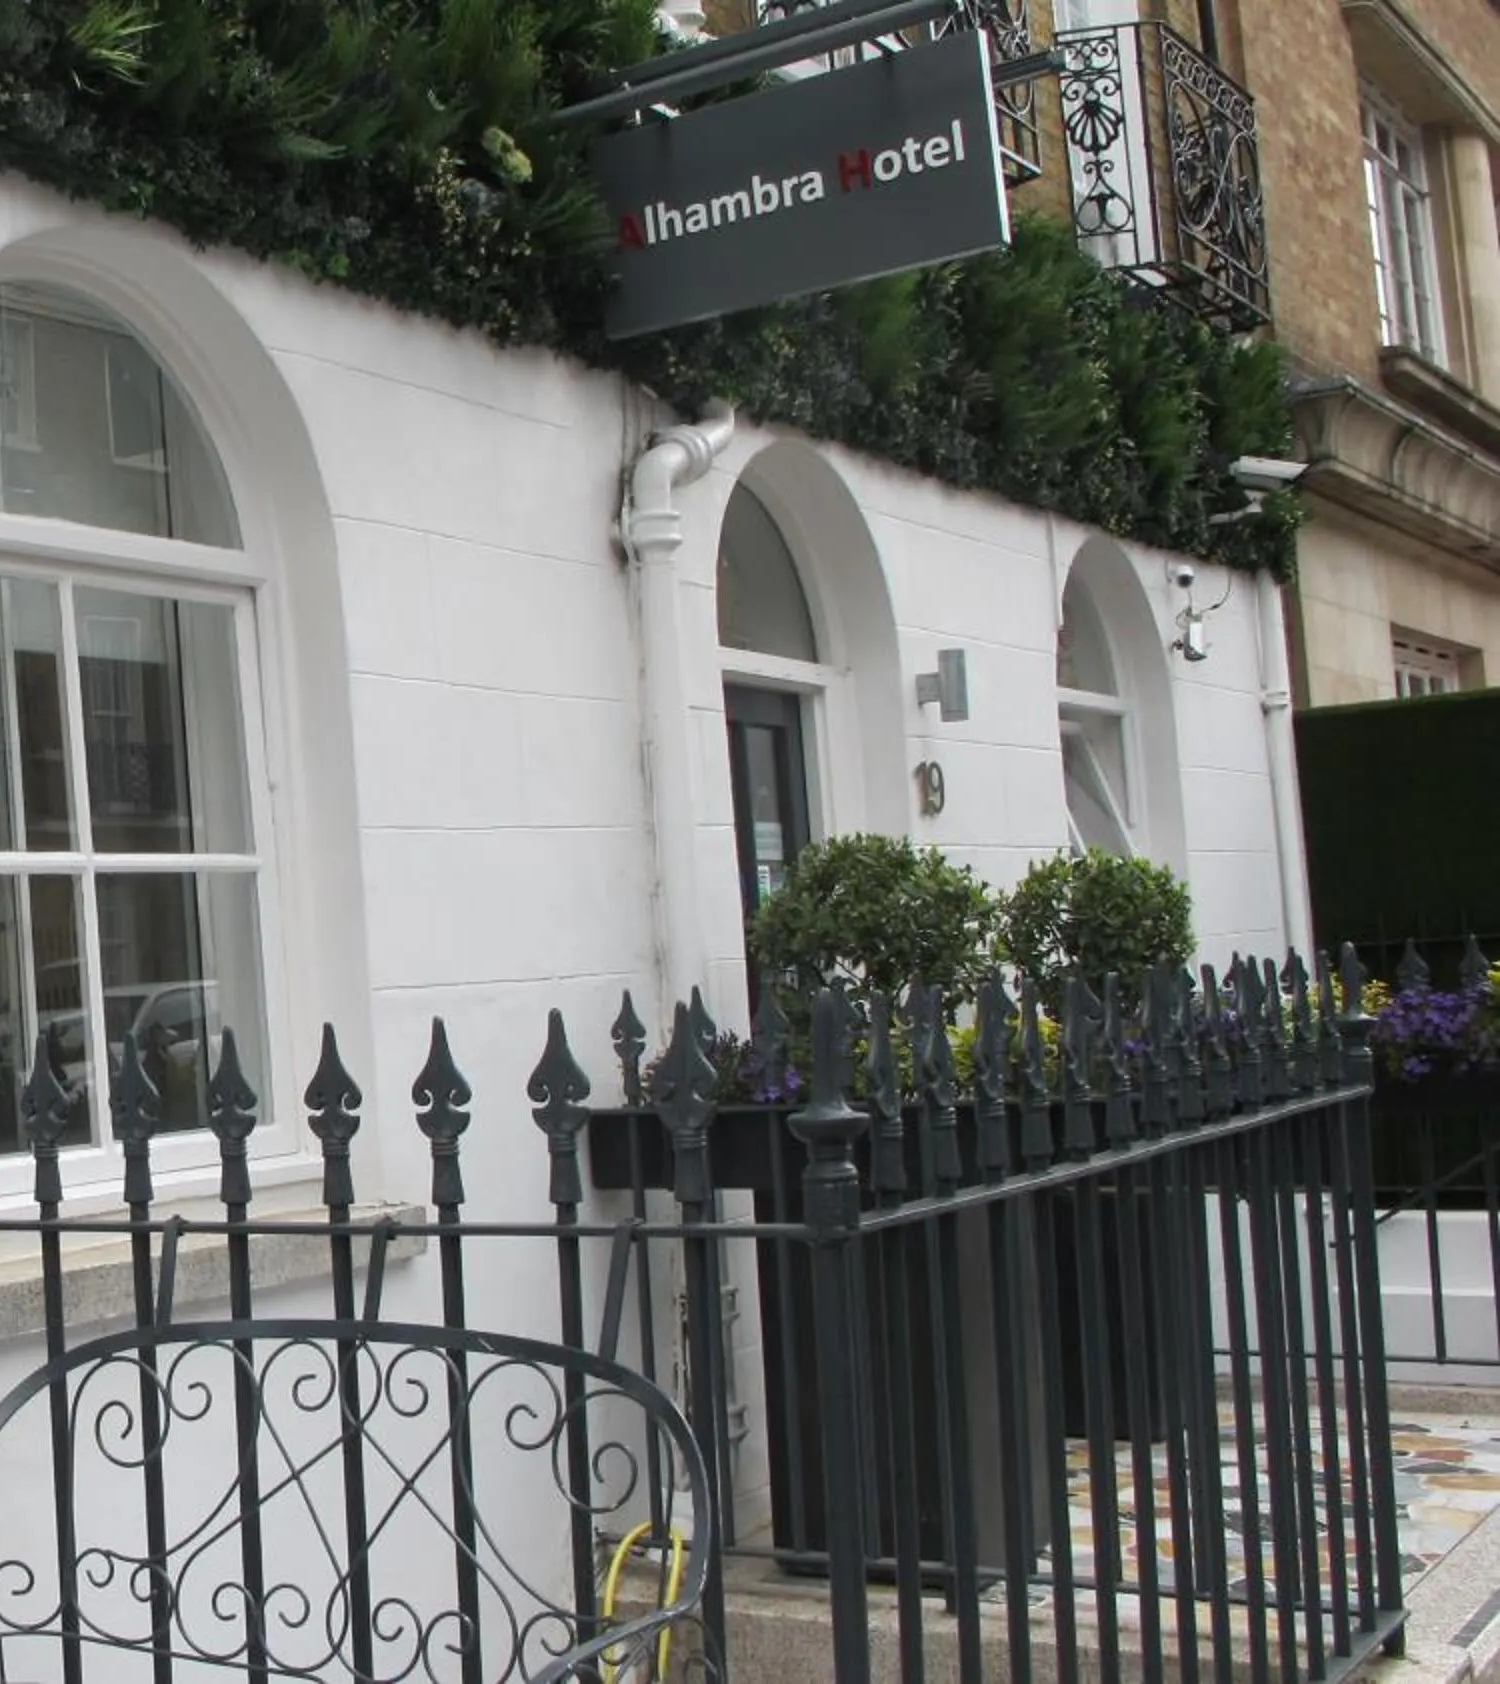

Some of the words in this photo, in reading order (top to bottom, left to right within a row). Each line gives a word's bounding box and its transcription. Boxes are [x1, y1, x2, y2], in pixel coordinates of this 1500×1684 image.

[618, 169, 824, 249] Alhambra
[838, 119, 965, 193] Hotel
[913, 761, 945, 816] 19
